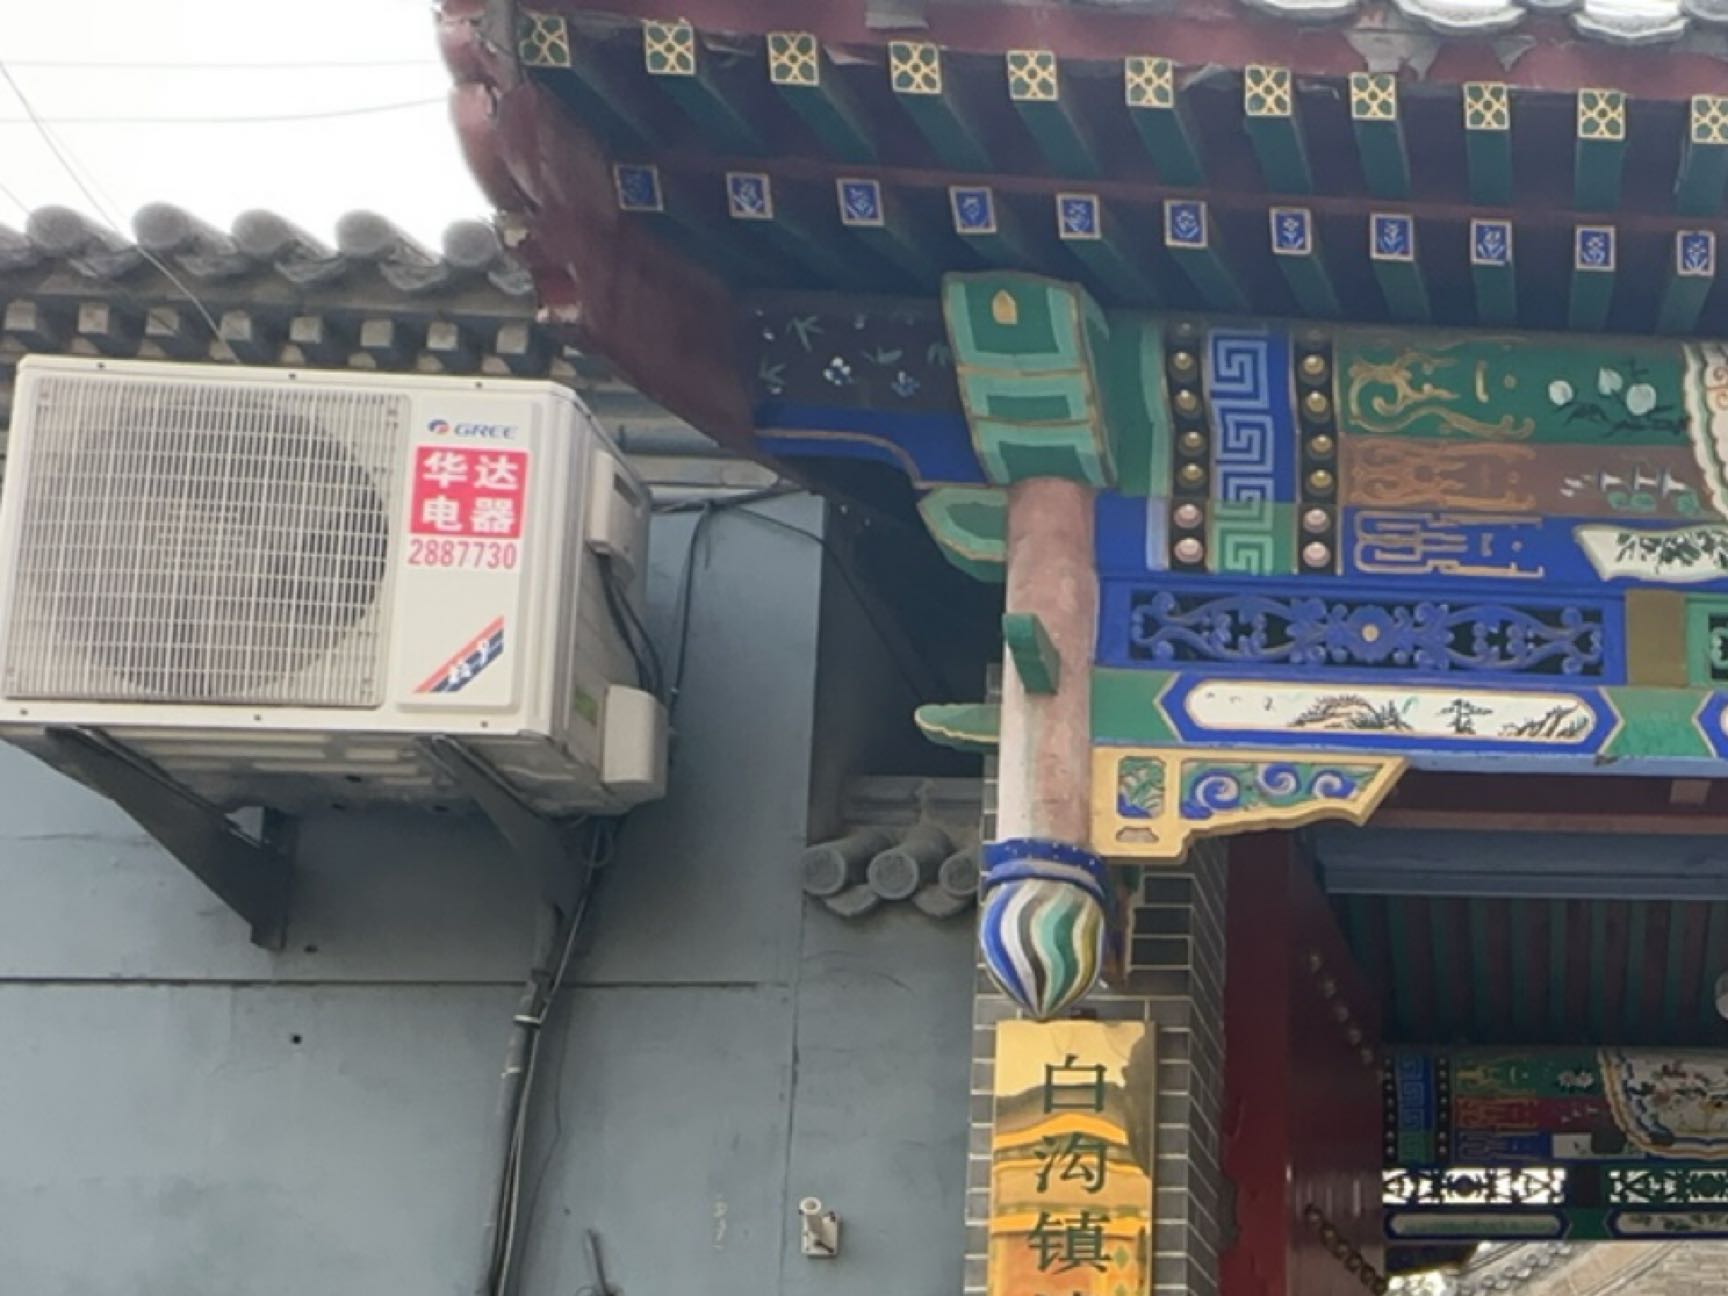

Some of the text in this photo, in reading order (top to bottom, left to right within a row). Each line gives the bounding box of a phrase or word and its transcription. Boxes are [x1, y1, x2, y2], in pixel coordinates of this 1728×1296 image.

[454, 421, 519, 440] GREE
[422, 451, 519, 491] 华达
[421, 494, 515, 534] 电器
[408, 538, 518, 570] 2887730
